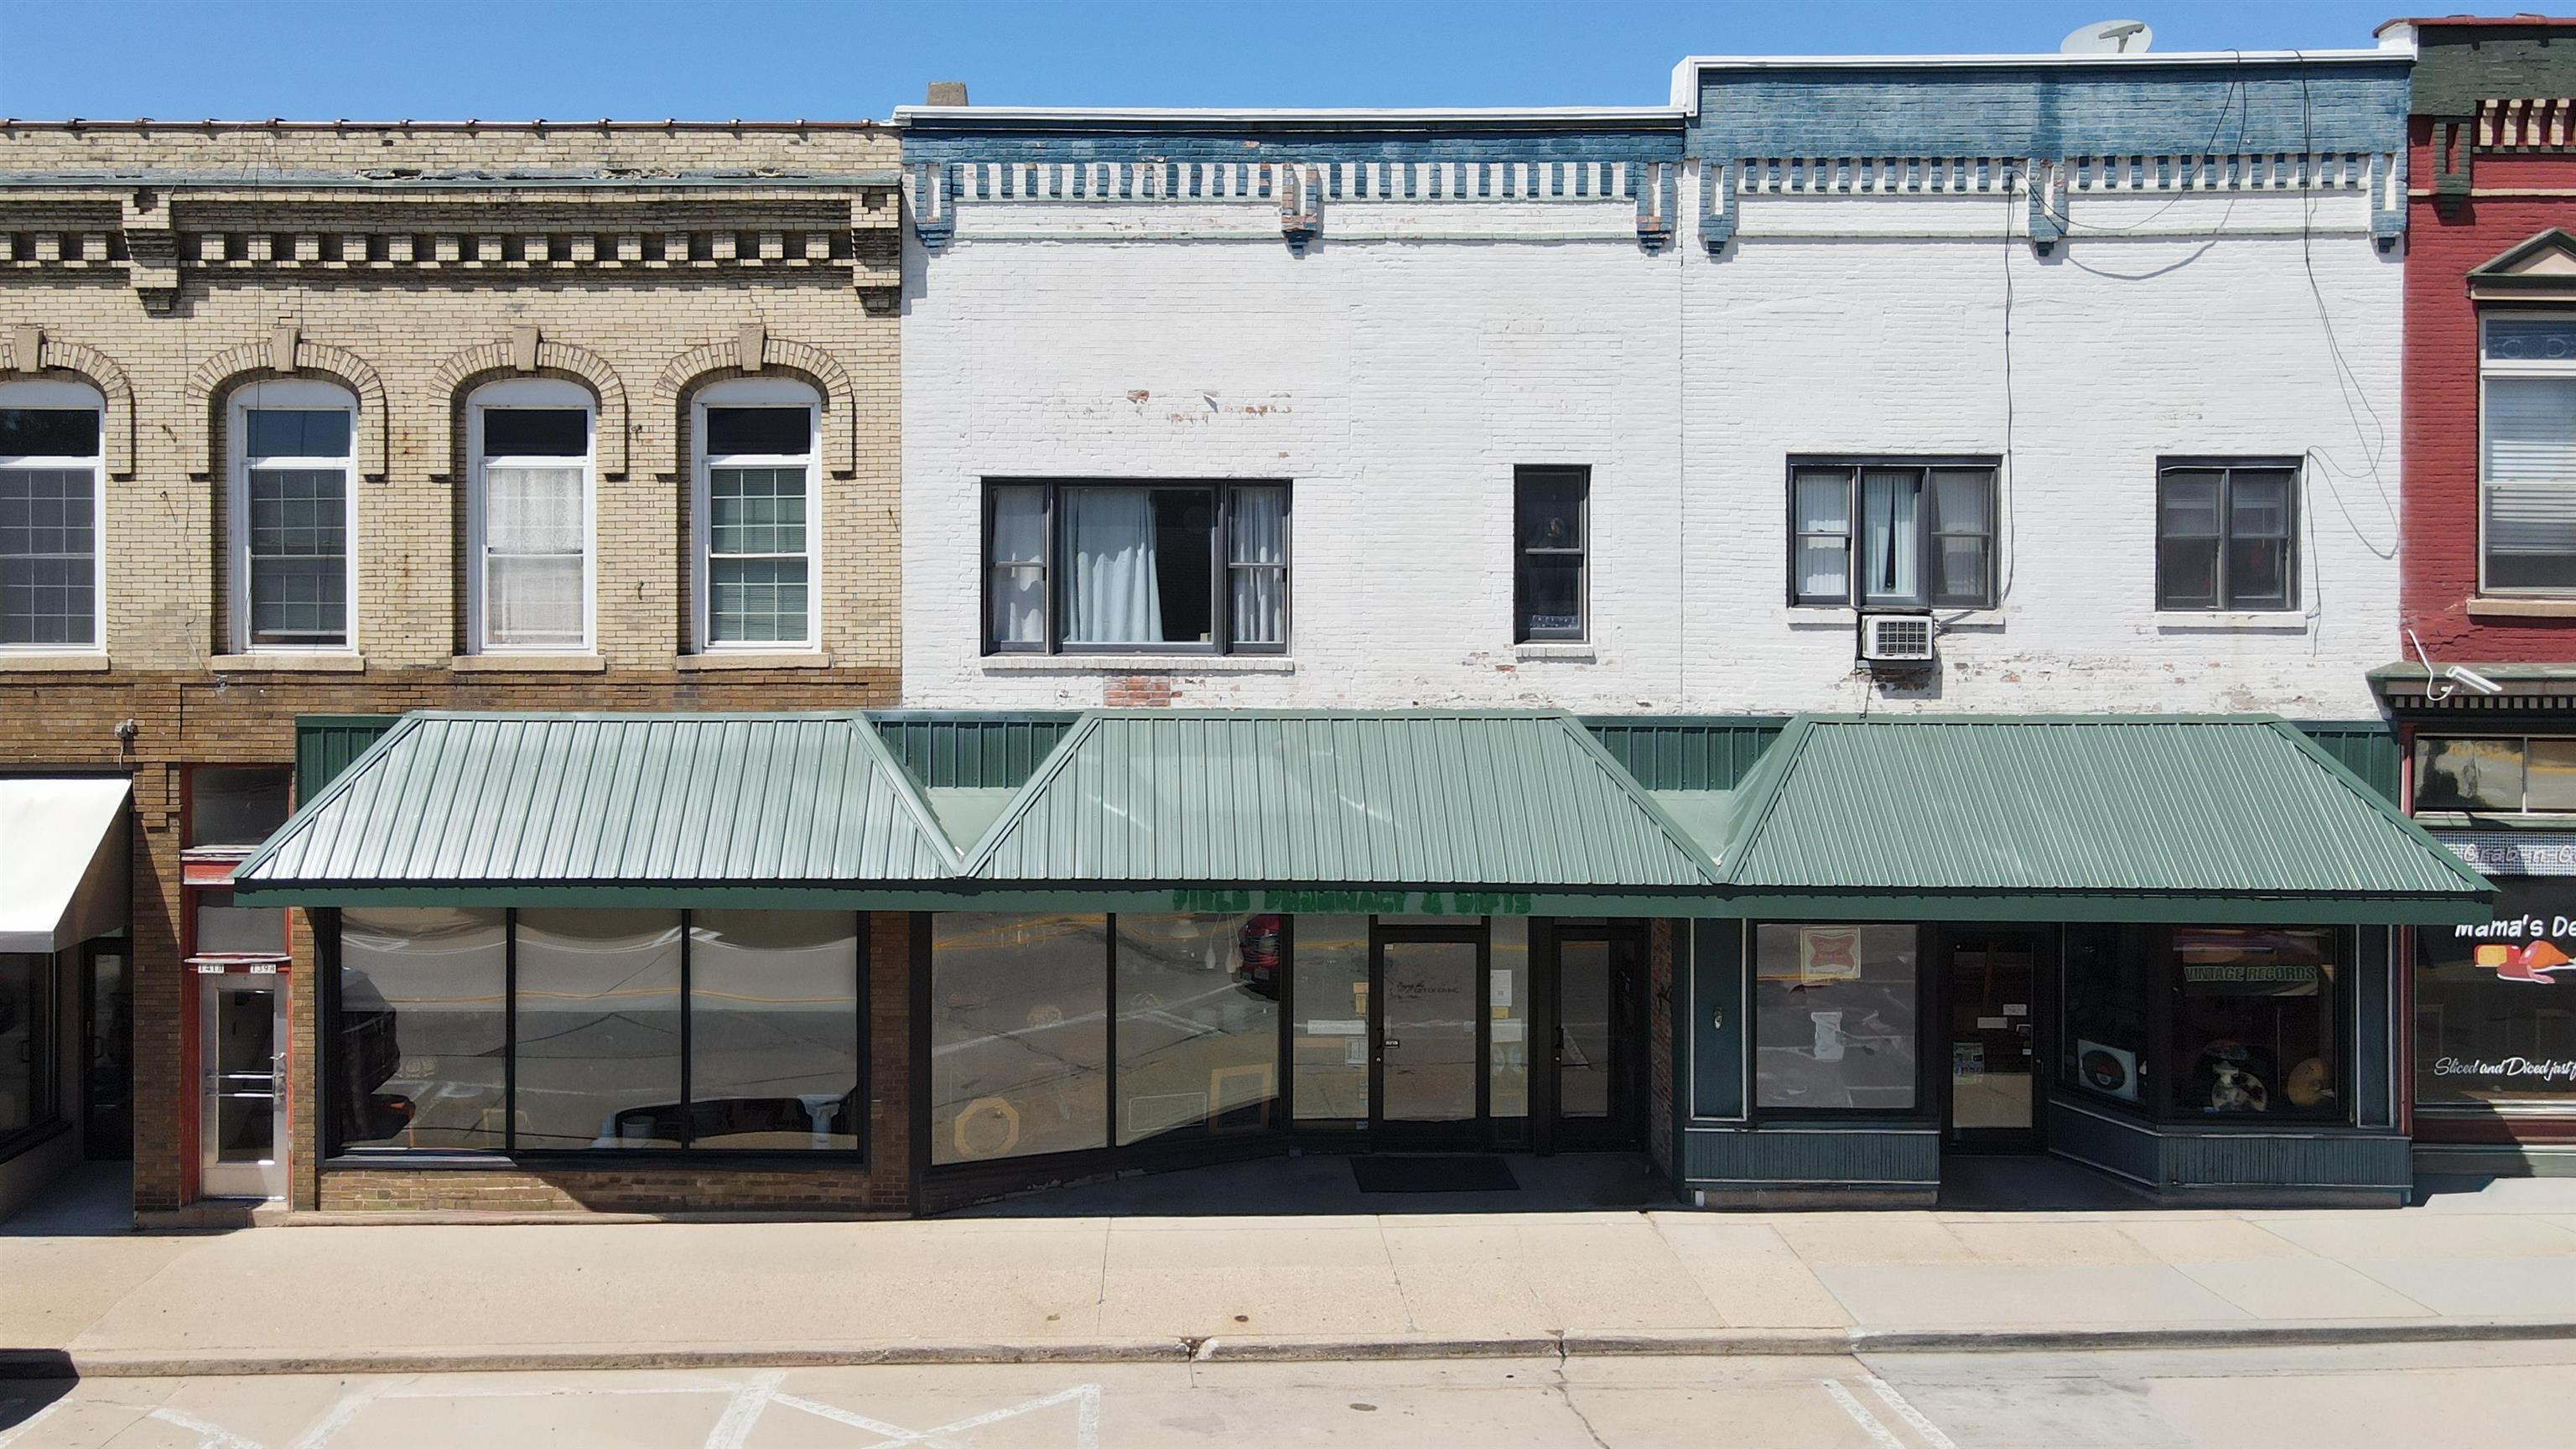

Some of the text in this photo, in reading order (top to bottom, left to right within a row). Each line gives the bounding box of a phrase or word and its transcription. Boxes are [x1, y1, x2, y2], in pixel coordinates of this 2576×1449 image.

[2455, 914, 2543, 937] Mama's
[2184, 966, 2317, 981] VINTAGE RECORDS
[2434, 1057, 2480, 1076] Sliced
[2480, 1060, 2506, 1074] and
[2506, 1057, 2551, 1076] Diced
